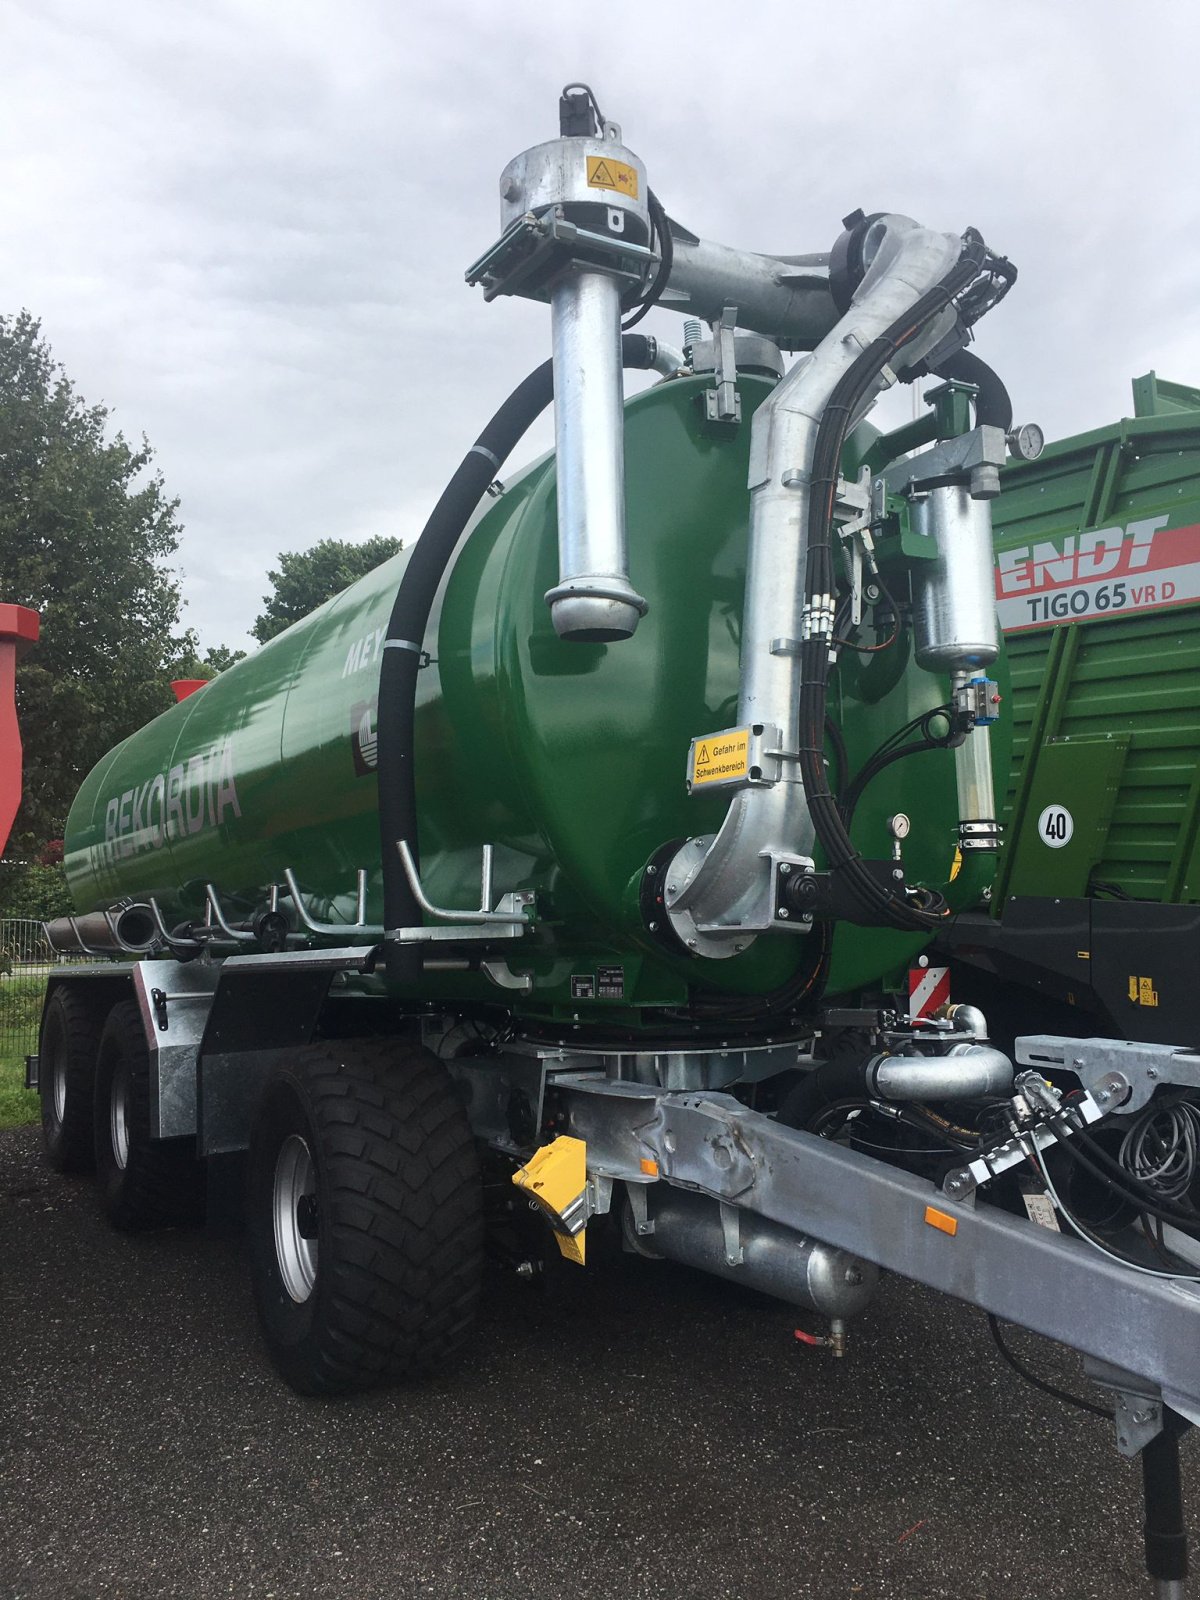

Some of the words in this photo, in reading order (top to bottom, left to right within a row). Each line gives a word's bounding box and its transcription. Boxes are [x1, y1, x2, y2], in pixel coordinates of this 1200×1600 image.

[992, 514, 1169, 593] ENDT
[1027, 590, 1090, 621] TIGO
[1095, 583, 1126, 610] 65
[1131, 585, 1156, 605] VR
[1162, 582, 1175, 600] D
[713, 744, 735, 756] Gefahr
[737, 742, 746, 751] im
[696, 760, 745, 778] Schwenkbereich
[105, 736, 242, 862] REKORDIA
[1045, 813, 1066, 840] 40
